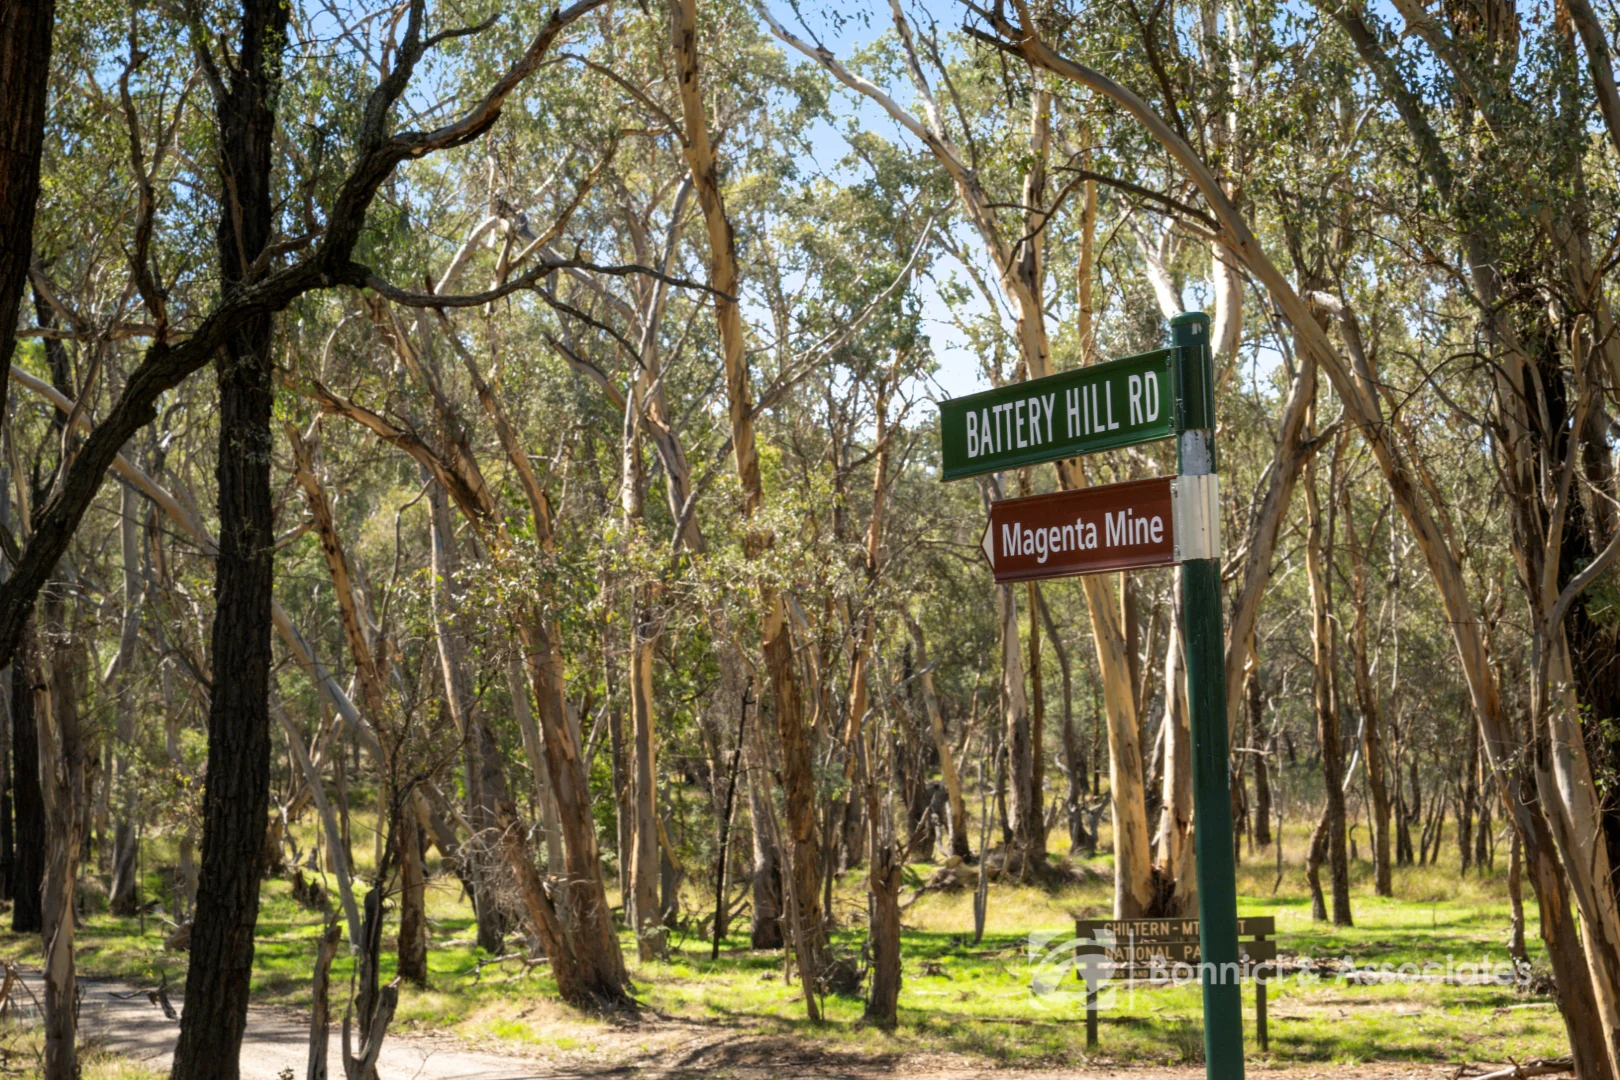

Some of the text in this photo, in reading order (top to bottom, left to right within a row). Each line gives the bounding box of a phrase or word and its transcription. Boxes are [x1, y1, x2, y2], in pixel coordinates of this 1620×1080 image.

[966, 370, 1160, 458] BATTERY HILL RD
[1001, 508, 1164, 564] Magenta Mine
[1104, 945, 1202, 961] NATIONAL PA
